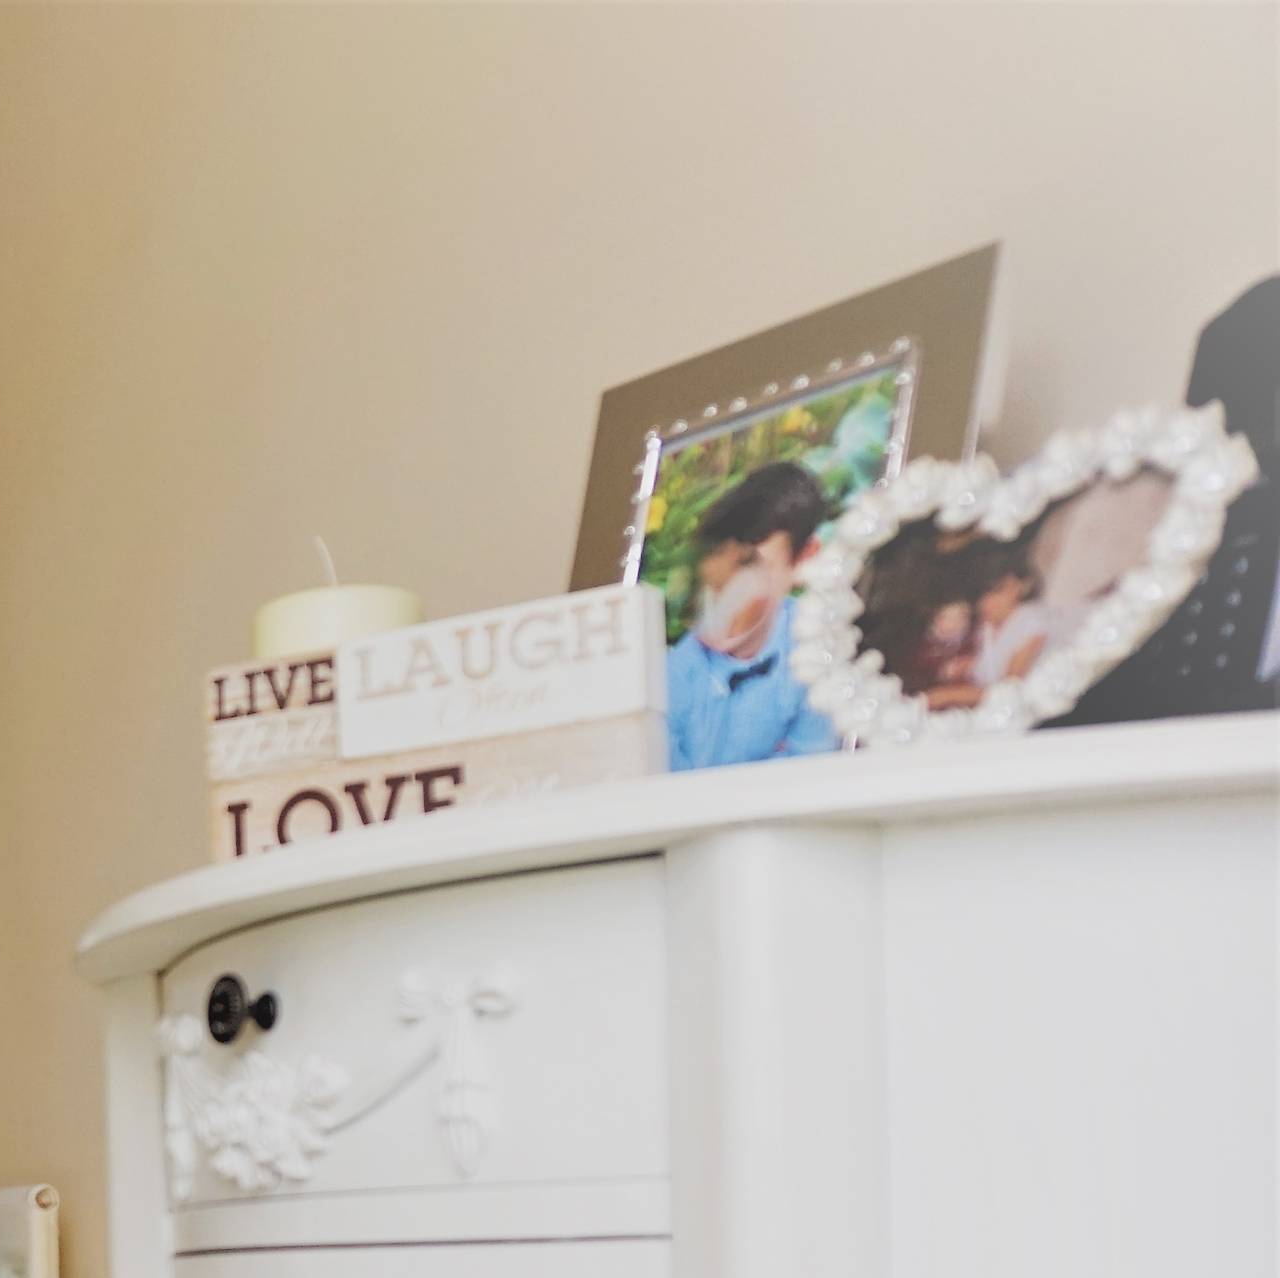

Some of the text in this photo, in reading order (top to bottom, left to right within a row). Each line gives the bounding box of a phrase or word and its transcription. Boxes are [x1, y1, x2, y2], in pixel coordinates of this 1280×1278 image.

[213, 656, 335, 721] LIVE
[354, 595, 630, 701] LAUGH
[227, 766, 464, 857] LOVE
